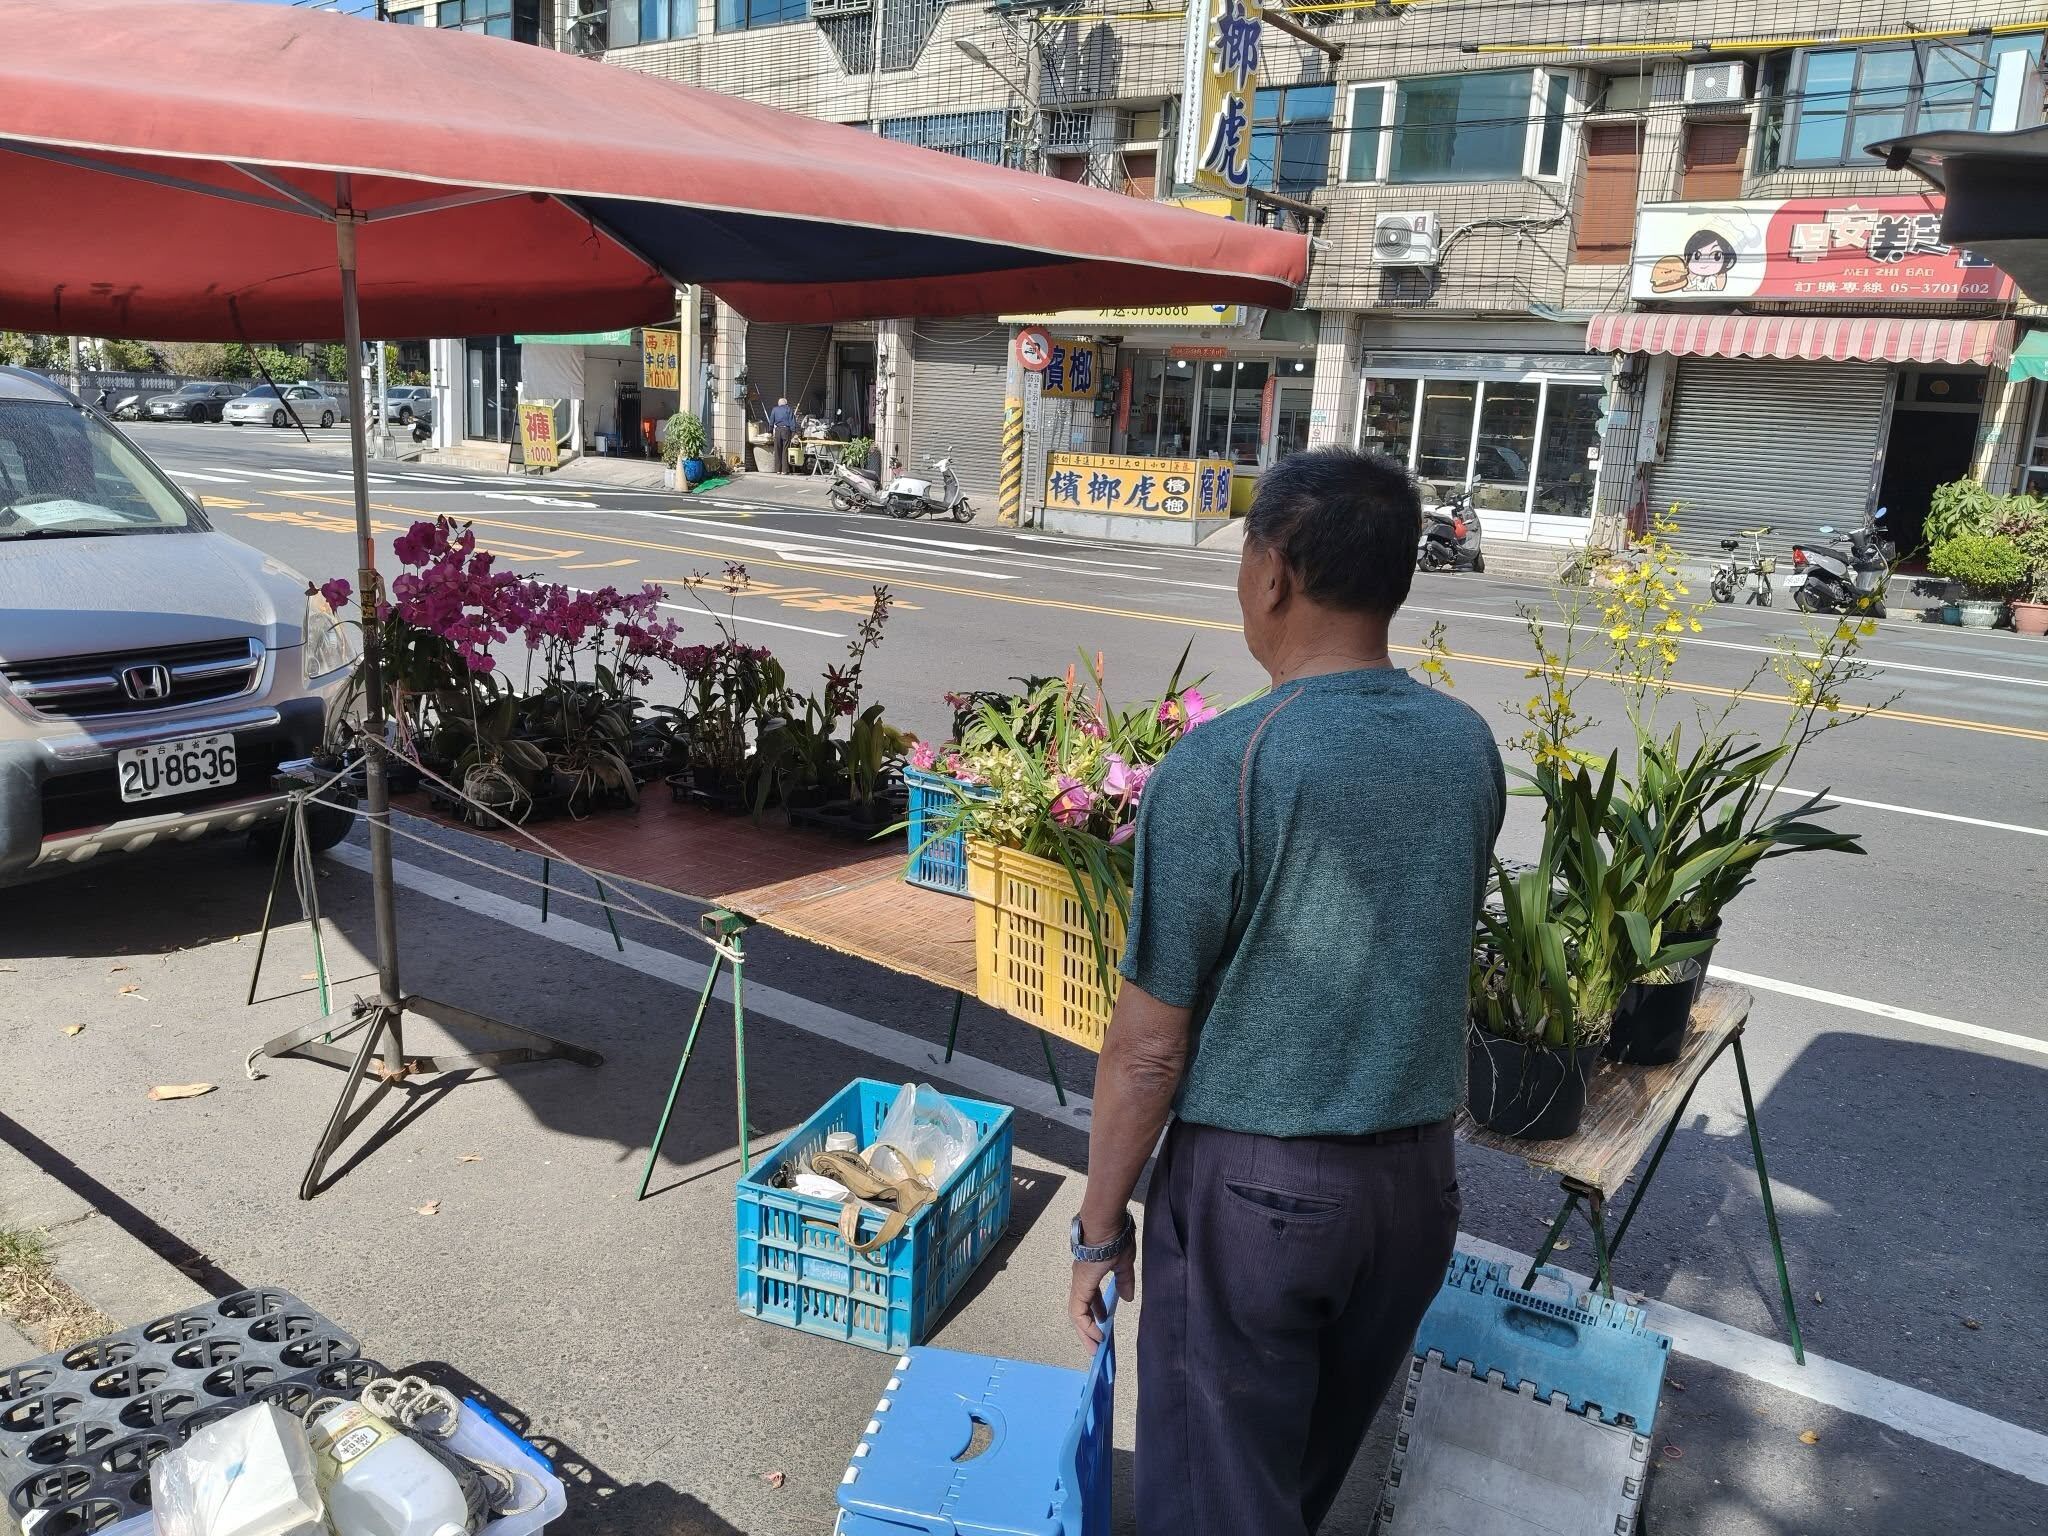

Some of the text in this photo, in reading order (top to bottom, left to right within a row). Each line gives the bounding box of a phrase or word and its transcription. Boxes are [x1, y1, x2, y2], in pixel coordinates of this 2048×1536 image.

[1205, 0, 1263, 187] 榔虎
[1789, 203, 1993, 268] 早安美芝
[1795, 281, 1989, 294] 訂購專線 05-3701602
[1844, 267, 1934, 277] MEI ZHI BAO
[525, 411, 550, 442] 褲
[531, 446, 552, 462] 1000
[1050, 470, 1159, 512] 檳榔虎
[1164, 478, 1186, 513] 檳榔
[1200, 466, 1231, 513] 檳榔
